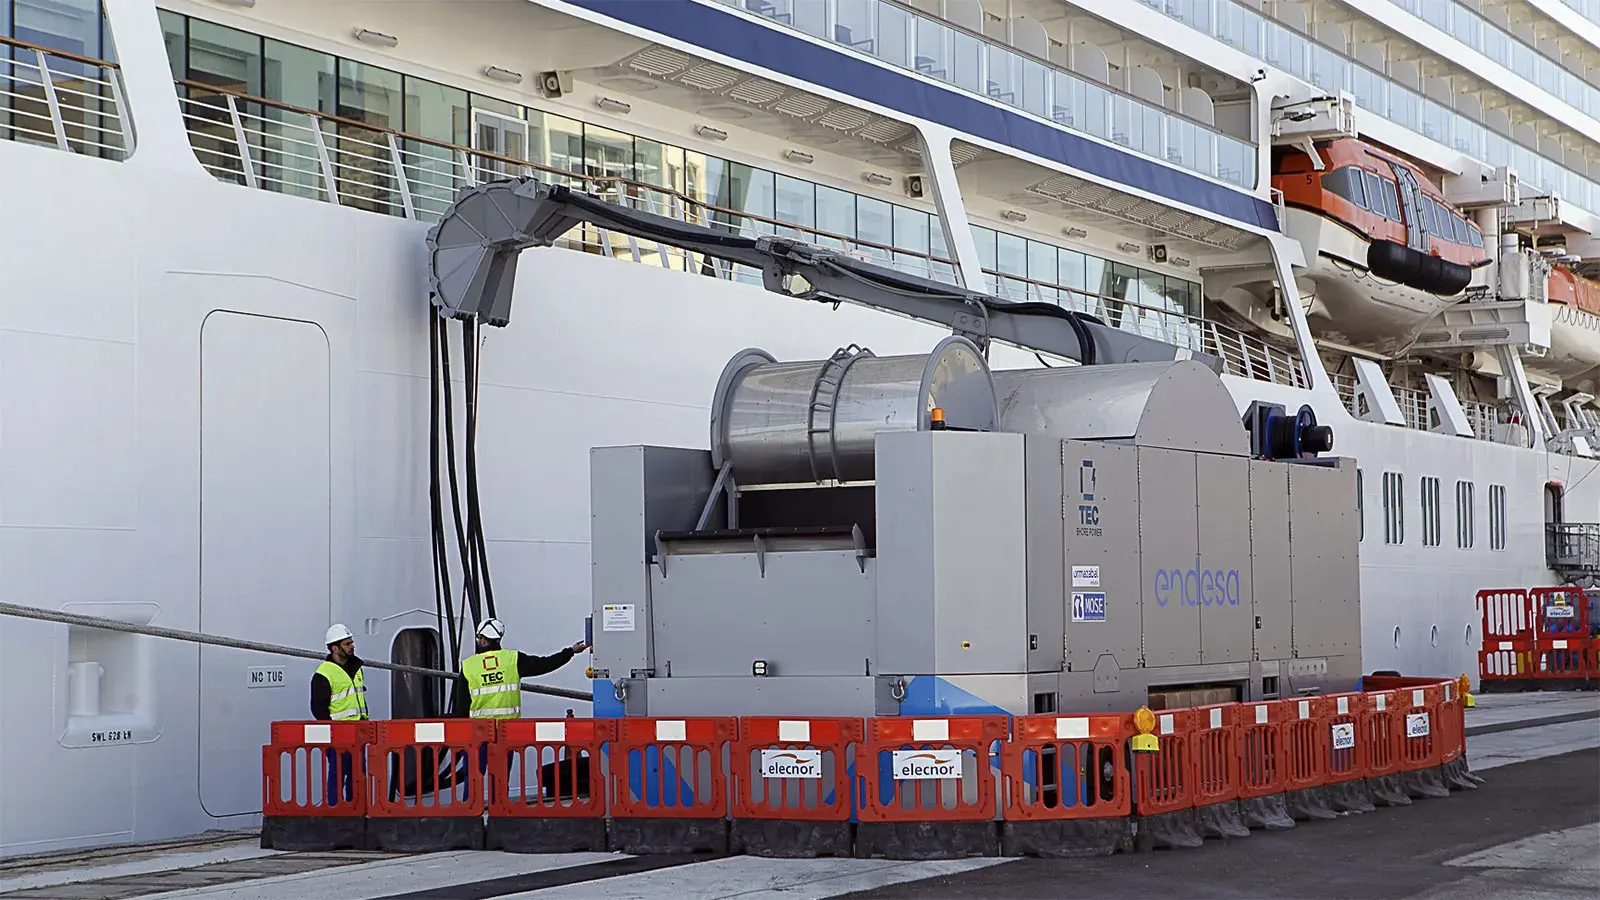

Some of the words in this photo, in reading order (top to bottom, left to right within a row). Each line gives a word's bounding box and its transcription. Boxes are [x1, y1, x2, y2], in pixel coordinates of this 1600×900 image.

[1306, 174, 1312, 185] 5
[1078, 505, 1099, 525] TEC
[1154, 557, 1239, 607] endesa
[1084, 597, 1104, 614] MOSE
[251, 671, 264, 683] NO
[266, 670, 283, 683] TUG
[481, 671, 504, 683] TEC
[91, 732, 106, 742] SWL
[768, 762, 815, 775] elecnor
[901, 763, 954, 776] elecnor
